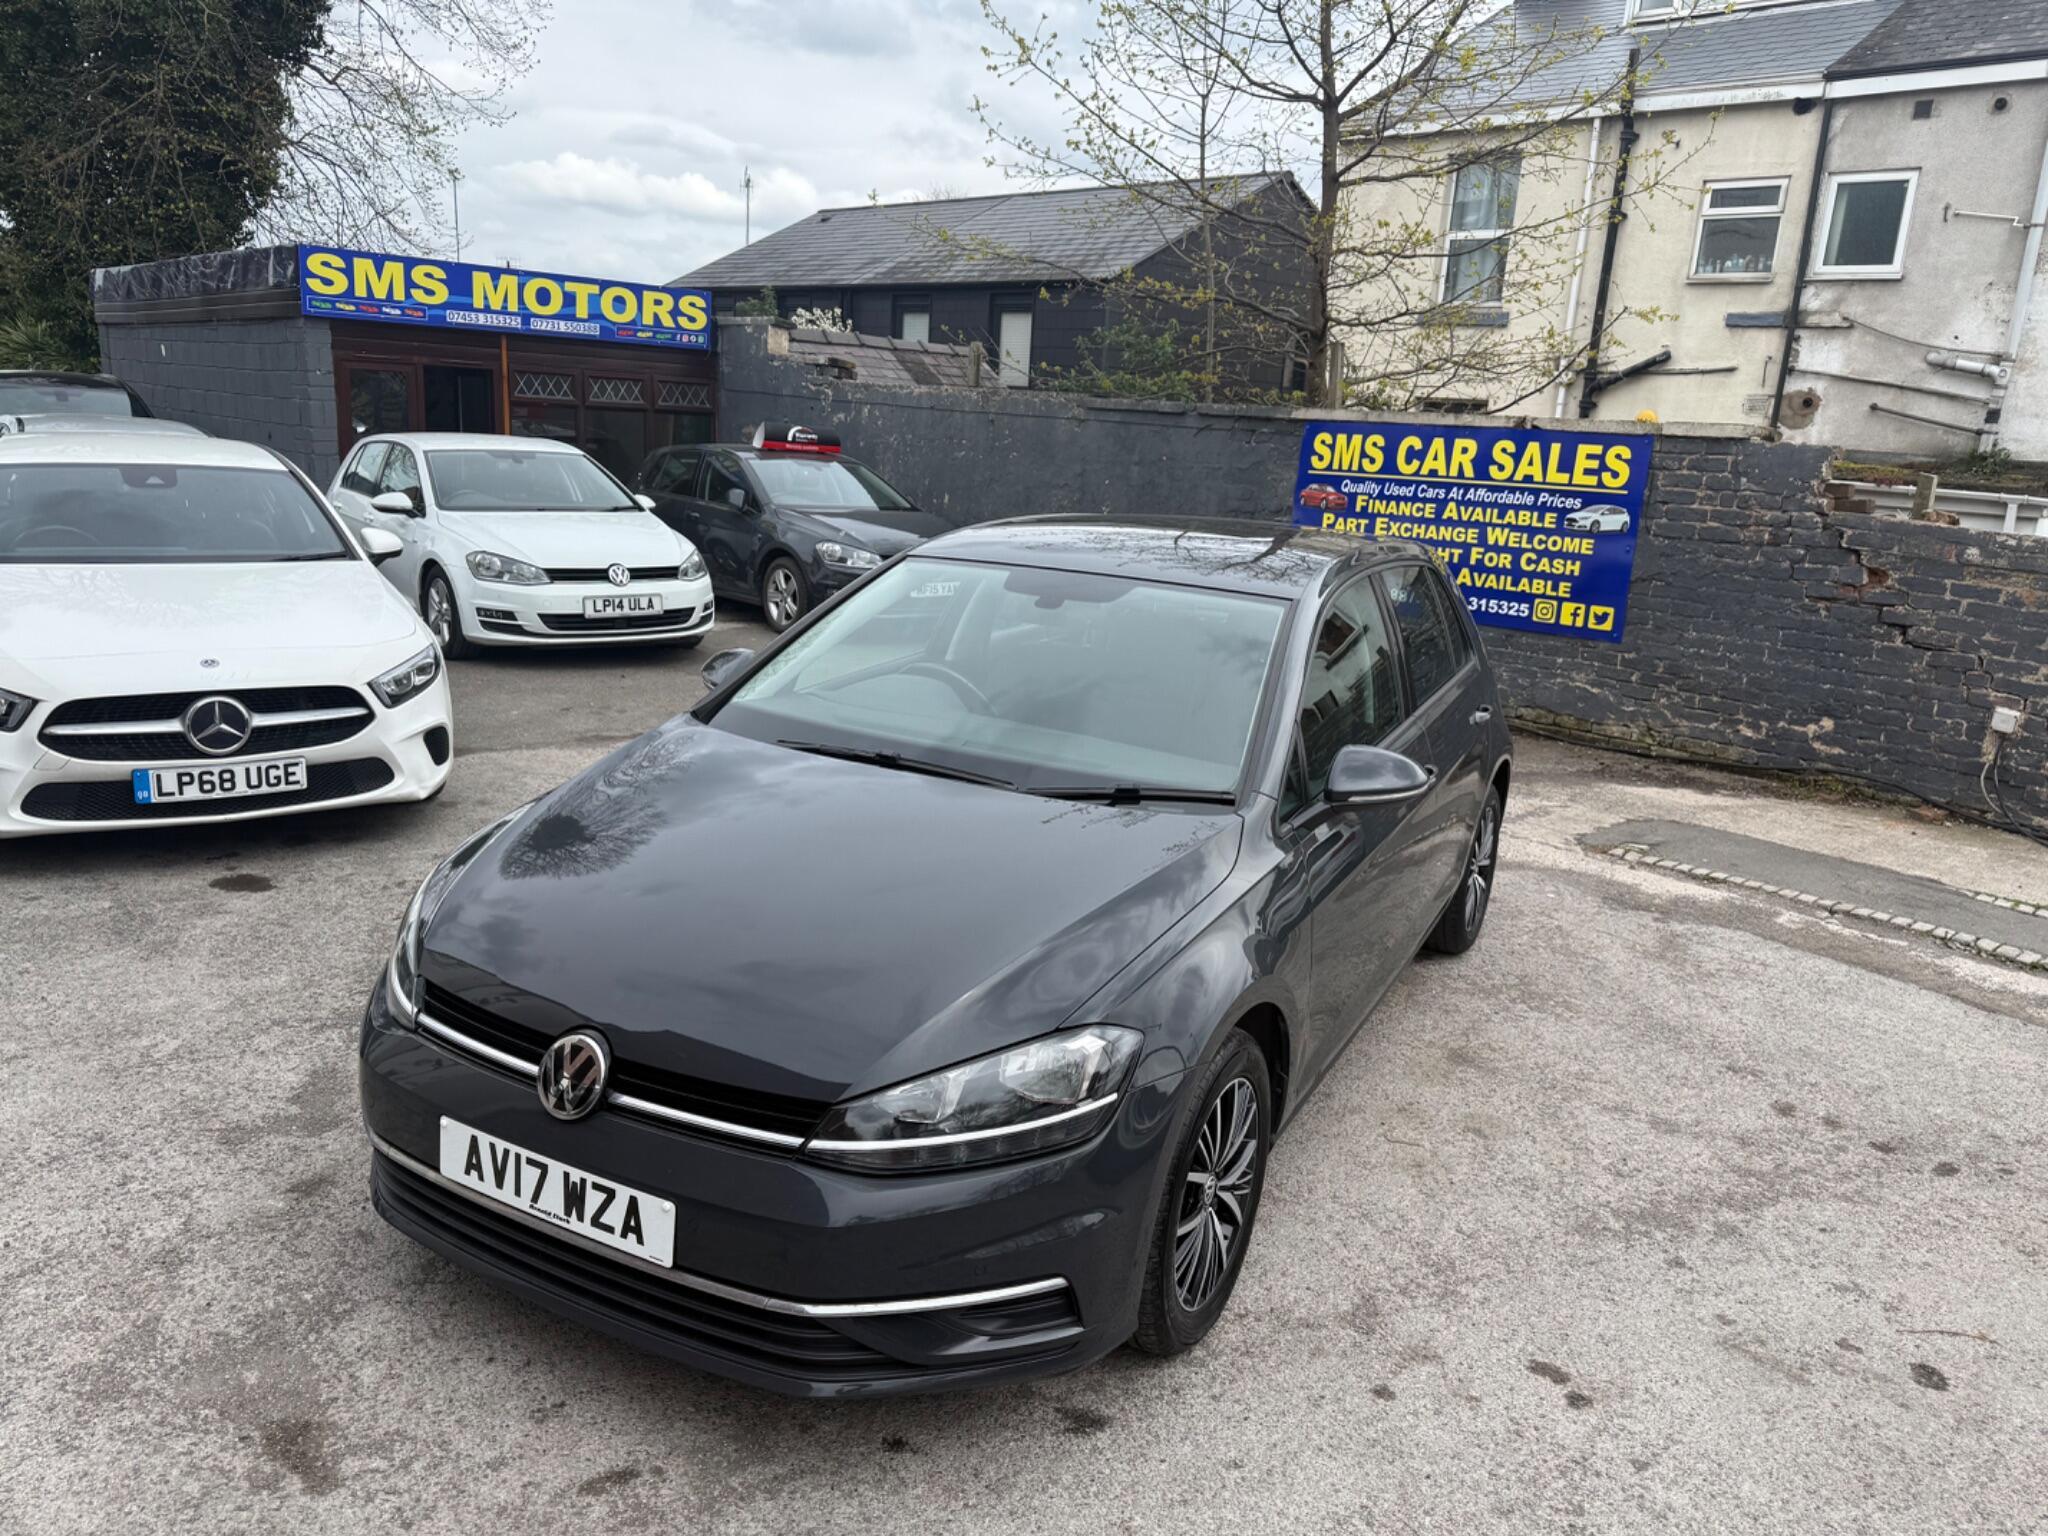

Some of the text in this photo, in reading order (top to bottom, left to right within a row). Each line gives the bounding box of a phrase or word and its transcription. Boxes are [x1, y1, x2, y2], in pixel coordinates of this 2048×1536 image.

[306, 253, 708, 330] SMS MOTORS
[1311, 432, 1632, 488] SMS CAR SALES
[1341, 479, 1582, 509] Quality Used Cars At Affordable Prices
[1355, 495, 1558, 528] FINANCE AVAILABLE
[1322, 512, 1369, 535] PART
[1374, 516, 1479, 544] EXCHANGE
[1486, 526, 1595, 555] WELCOME
[1470, 547, 1512, 569] FOR
[1520, 552, 1581, 576] CASH
[1456, 568, 1572, 598] AVAILABLE
[593, 597, 655, 613] LP14 ULA
[1468, 597, 1530, 617] 315325
[156, 762, 300, 797] LP68 UGE
[464, 1134, 645, 1247] AV17 WZA
